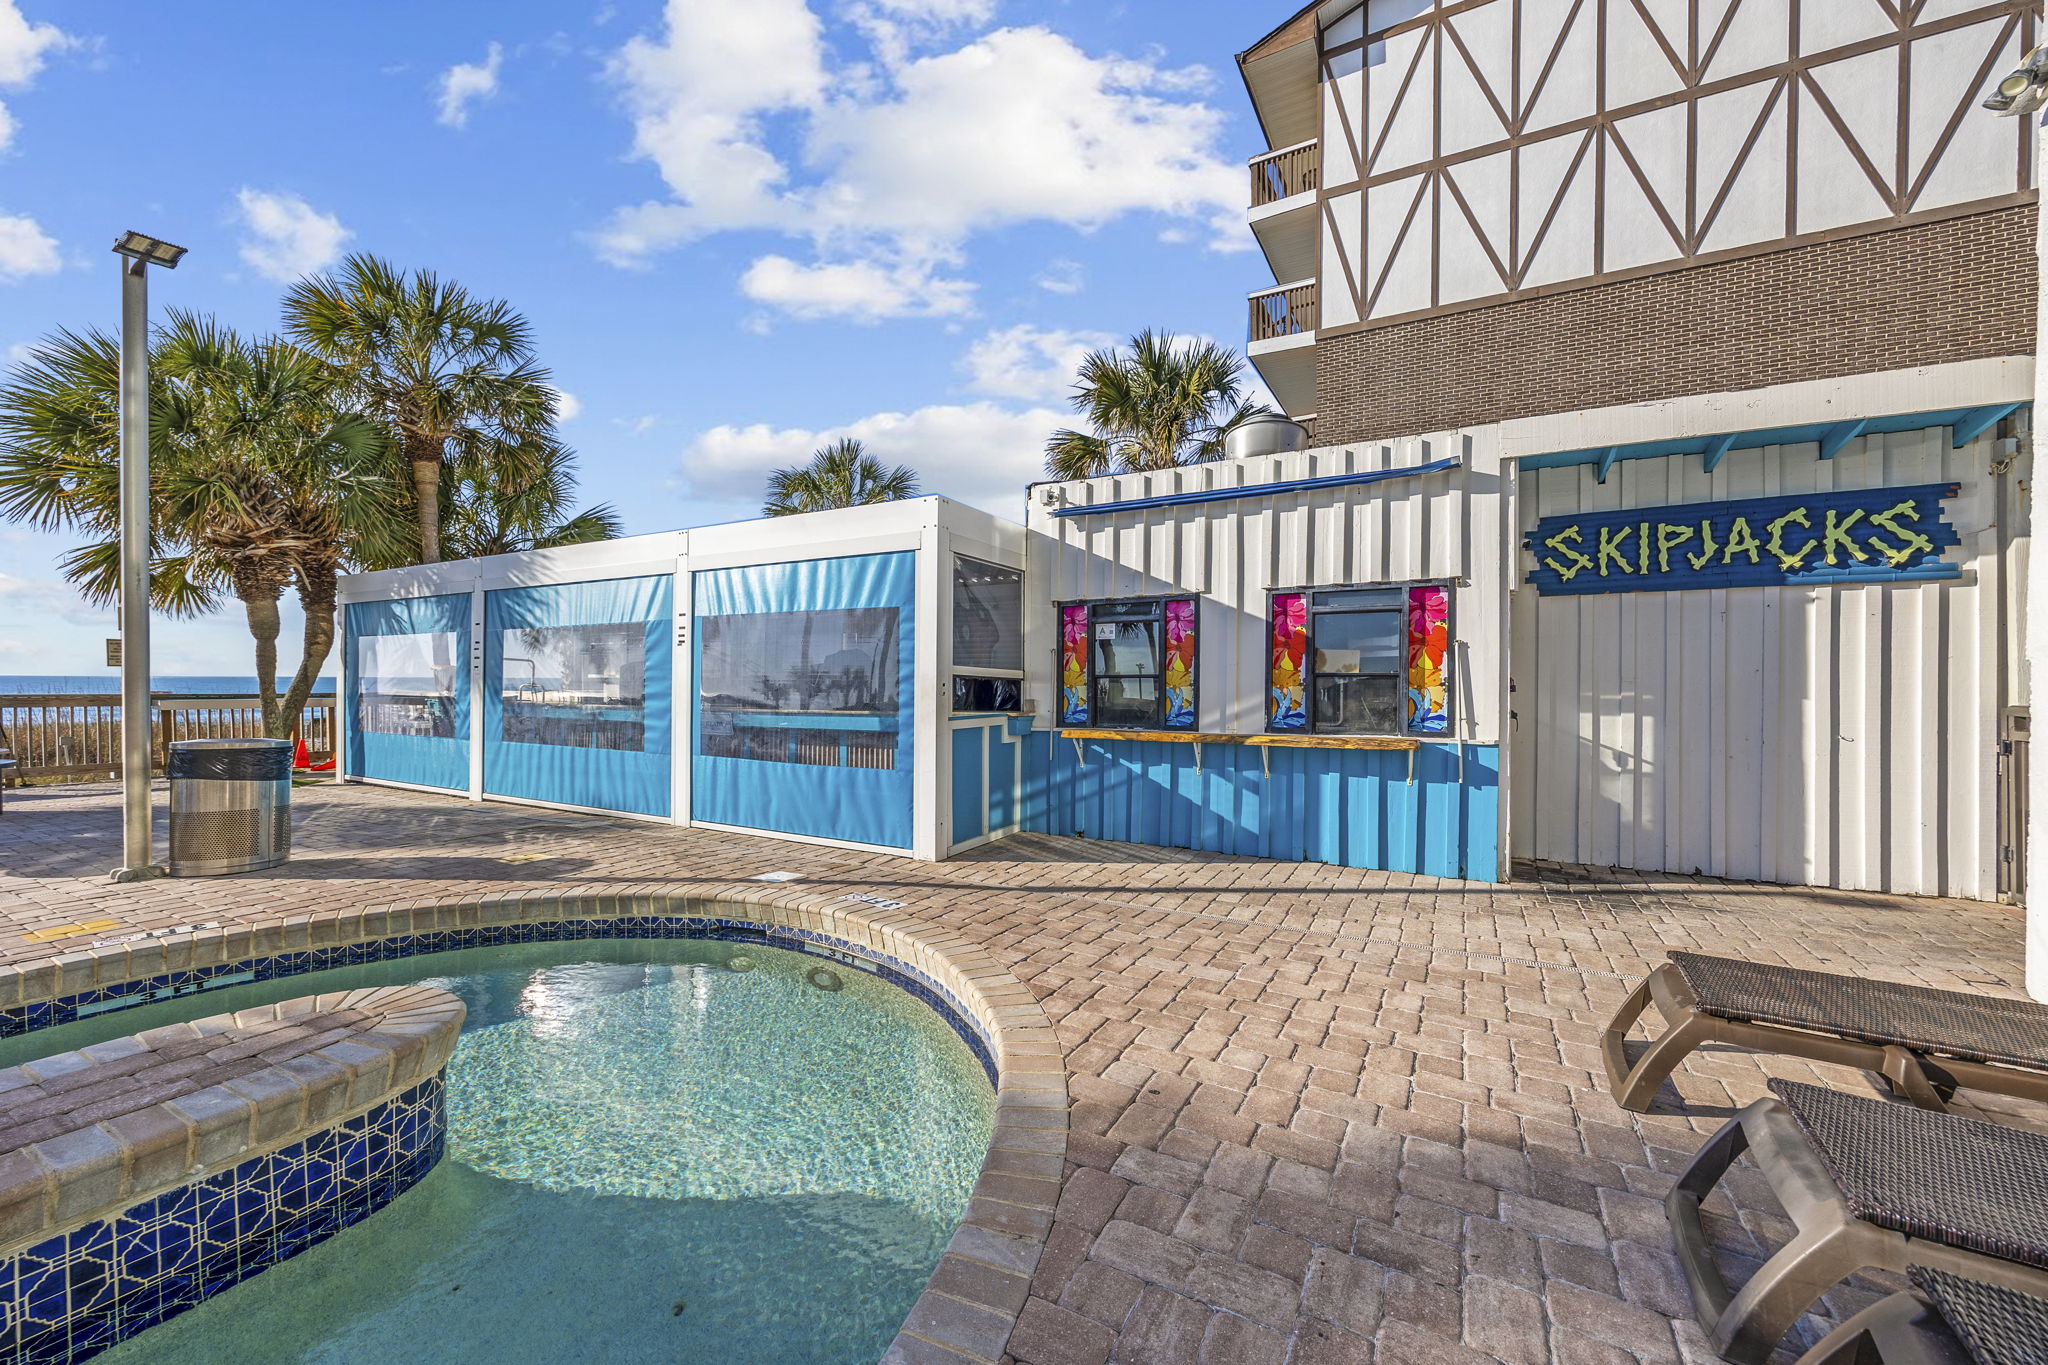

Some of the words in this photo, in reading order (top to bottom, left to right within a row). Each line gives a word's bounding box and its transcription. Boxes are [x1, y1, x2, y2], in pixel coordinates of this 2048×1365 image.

[1543, 499, 1935, 584] SKIPJACKS
[1099, 626, 1106, 635] A
[828, 948, 836, 957] 3
[842, 952, 858, 964] FT
[139, 991, 157, 1001] 3
[173, 980, 209, 994] FT
